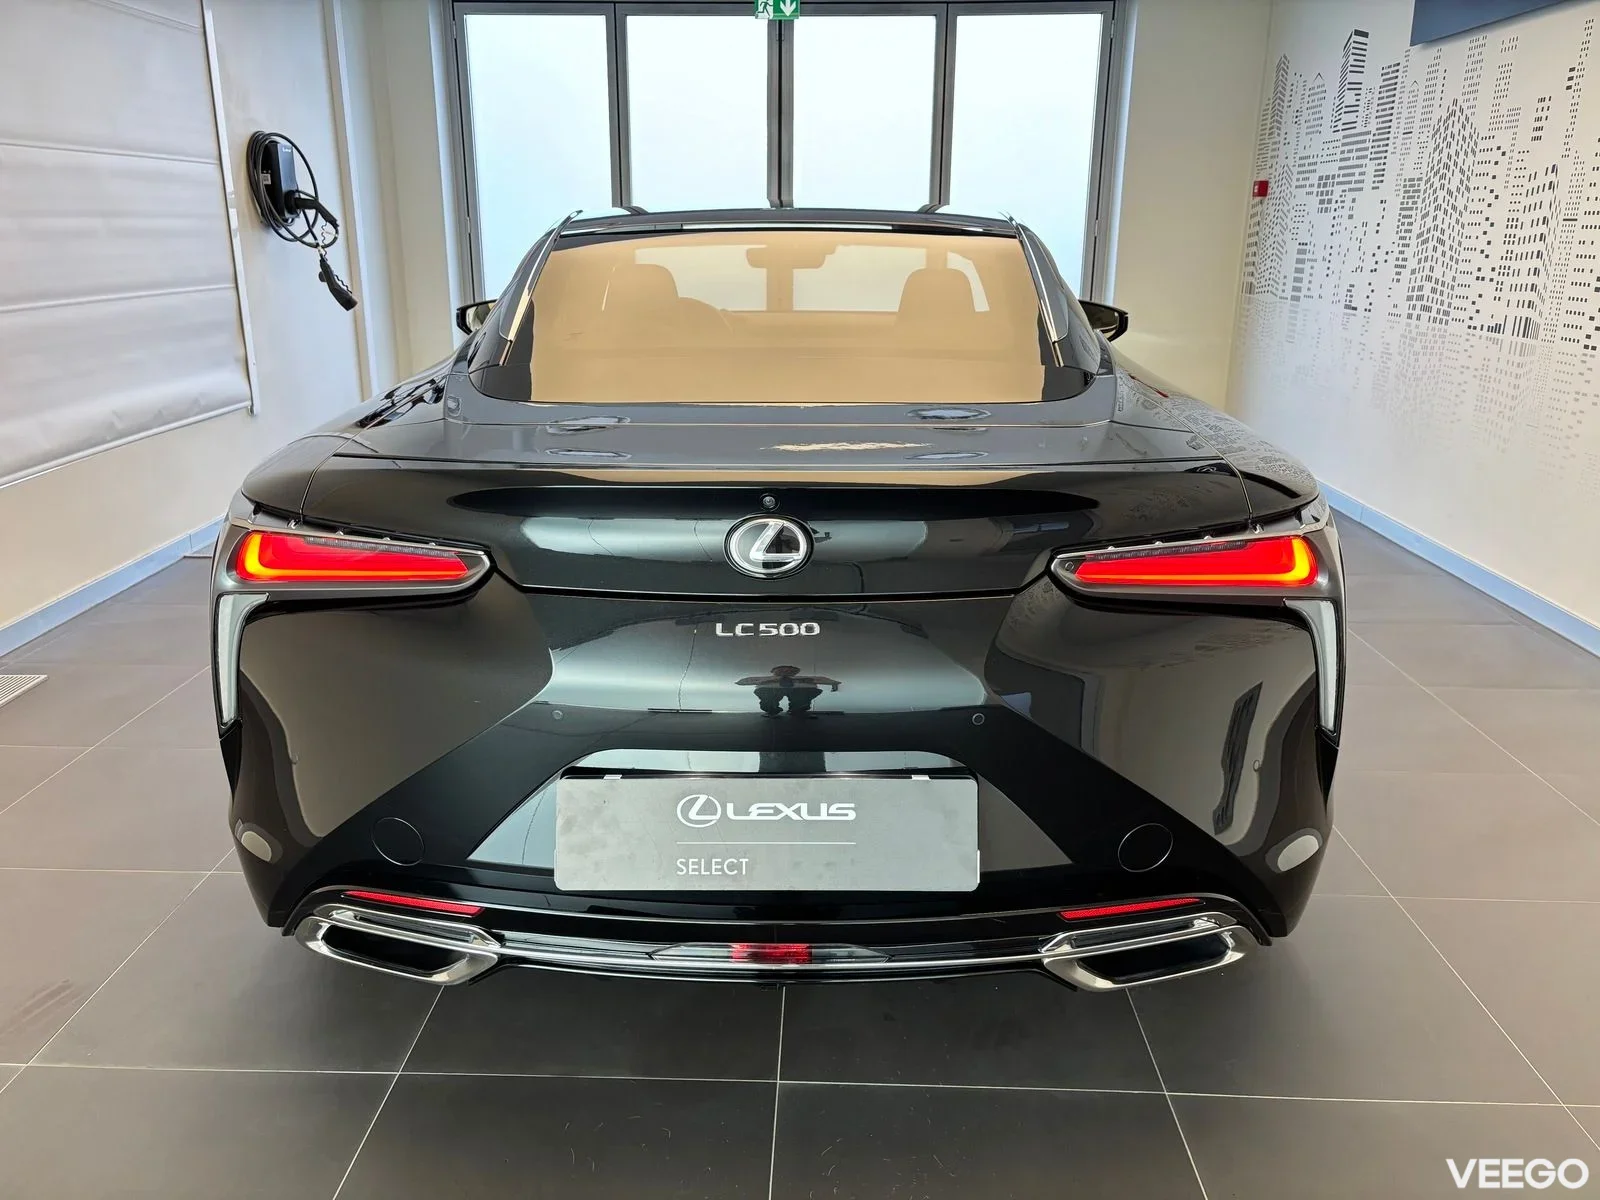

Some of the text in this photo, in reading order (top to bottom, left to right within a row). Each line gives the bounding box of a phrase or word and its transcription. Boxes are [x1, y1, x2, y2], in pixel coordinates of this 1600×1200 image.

[715, 622, 821, 637] LC 500
[726, 802, 857, 821] LEXUS
[676, 858, 749, 876] SELECT
